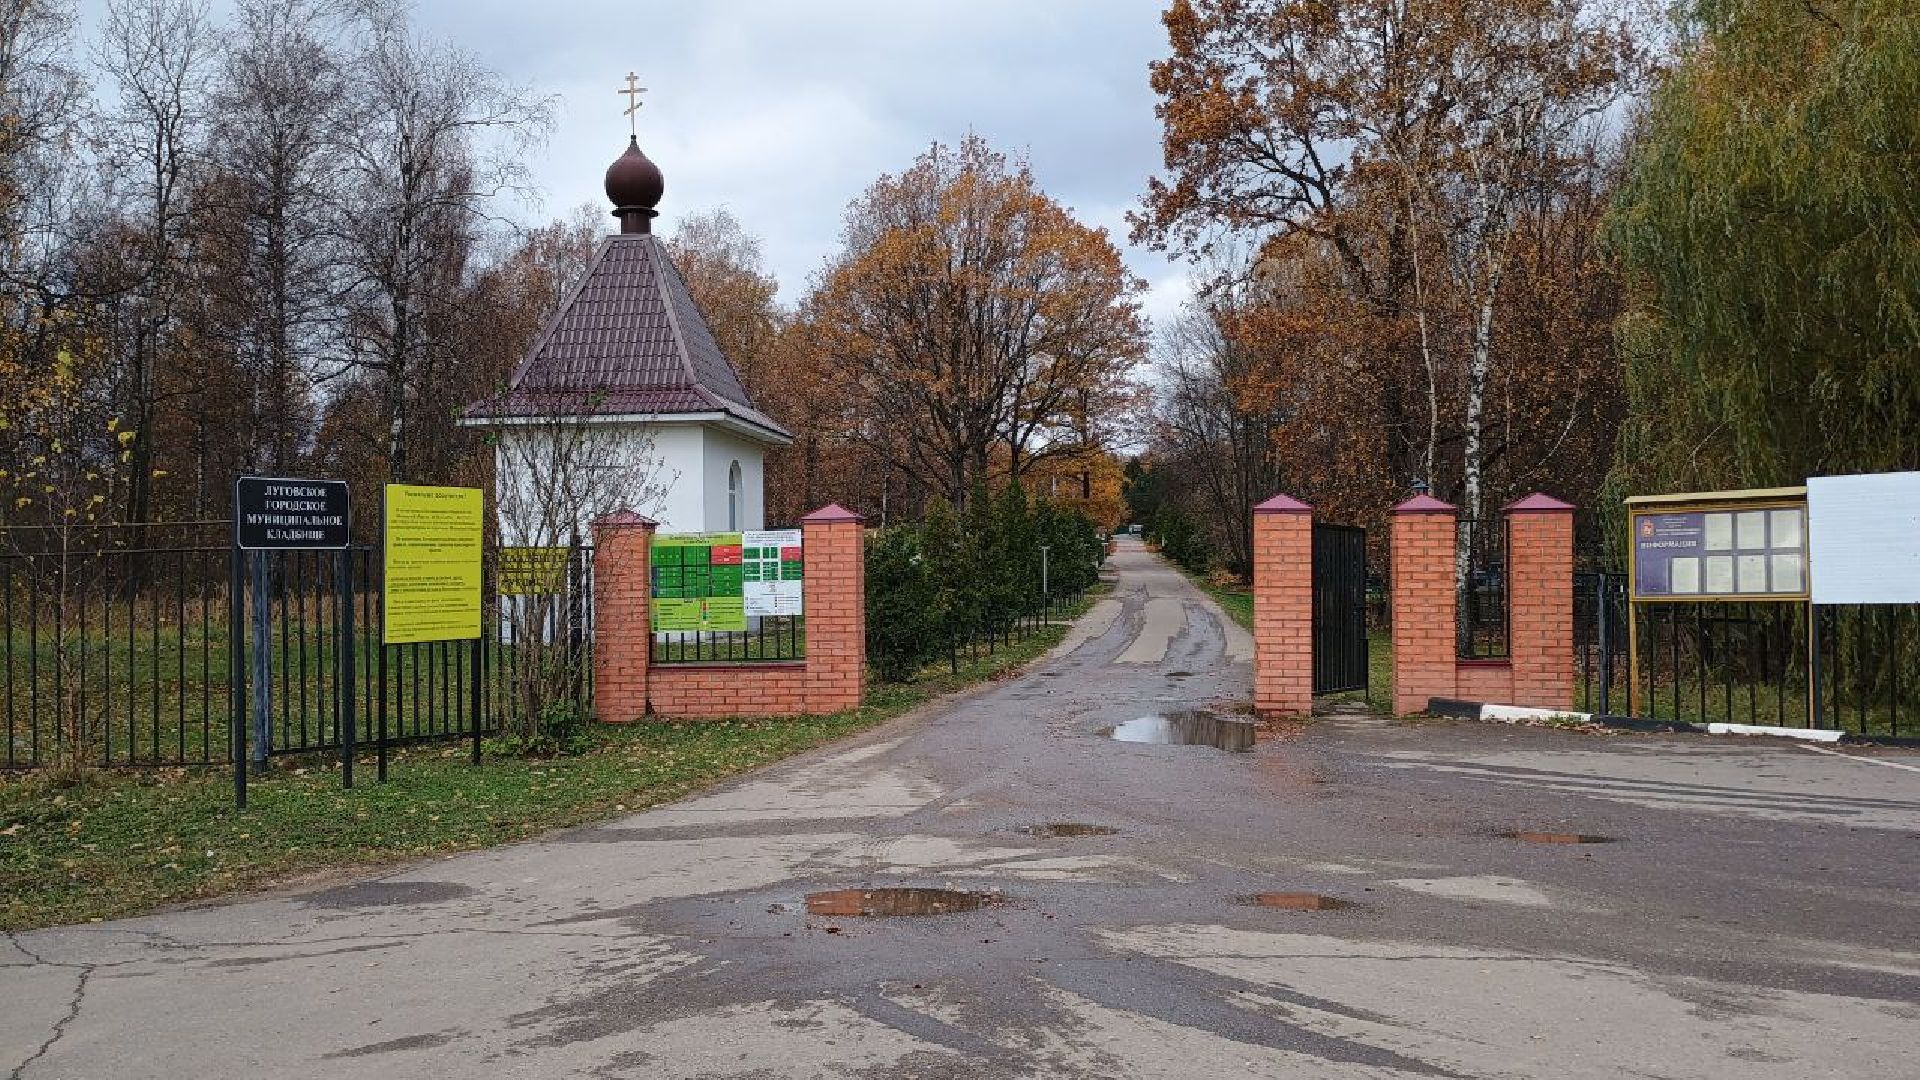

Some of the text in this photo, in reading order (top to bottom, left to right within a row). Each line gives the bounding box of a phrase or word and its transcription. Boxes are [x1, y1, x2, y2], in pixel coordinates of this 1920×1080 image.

[265, 486, 327, 496] ЛУГОВСКОЕ
[265, 500, 328, 511] ГОРОДСКОЕ
[246, 513, 343, 526] МУНИЦИПАЛЬНОЕ
